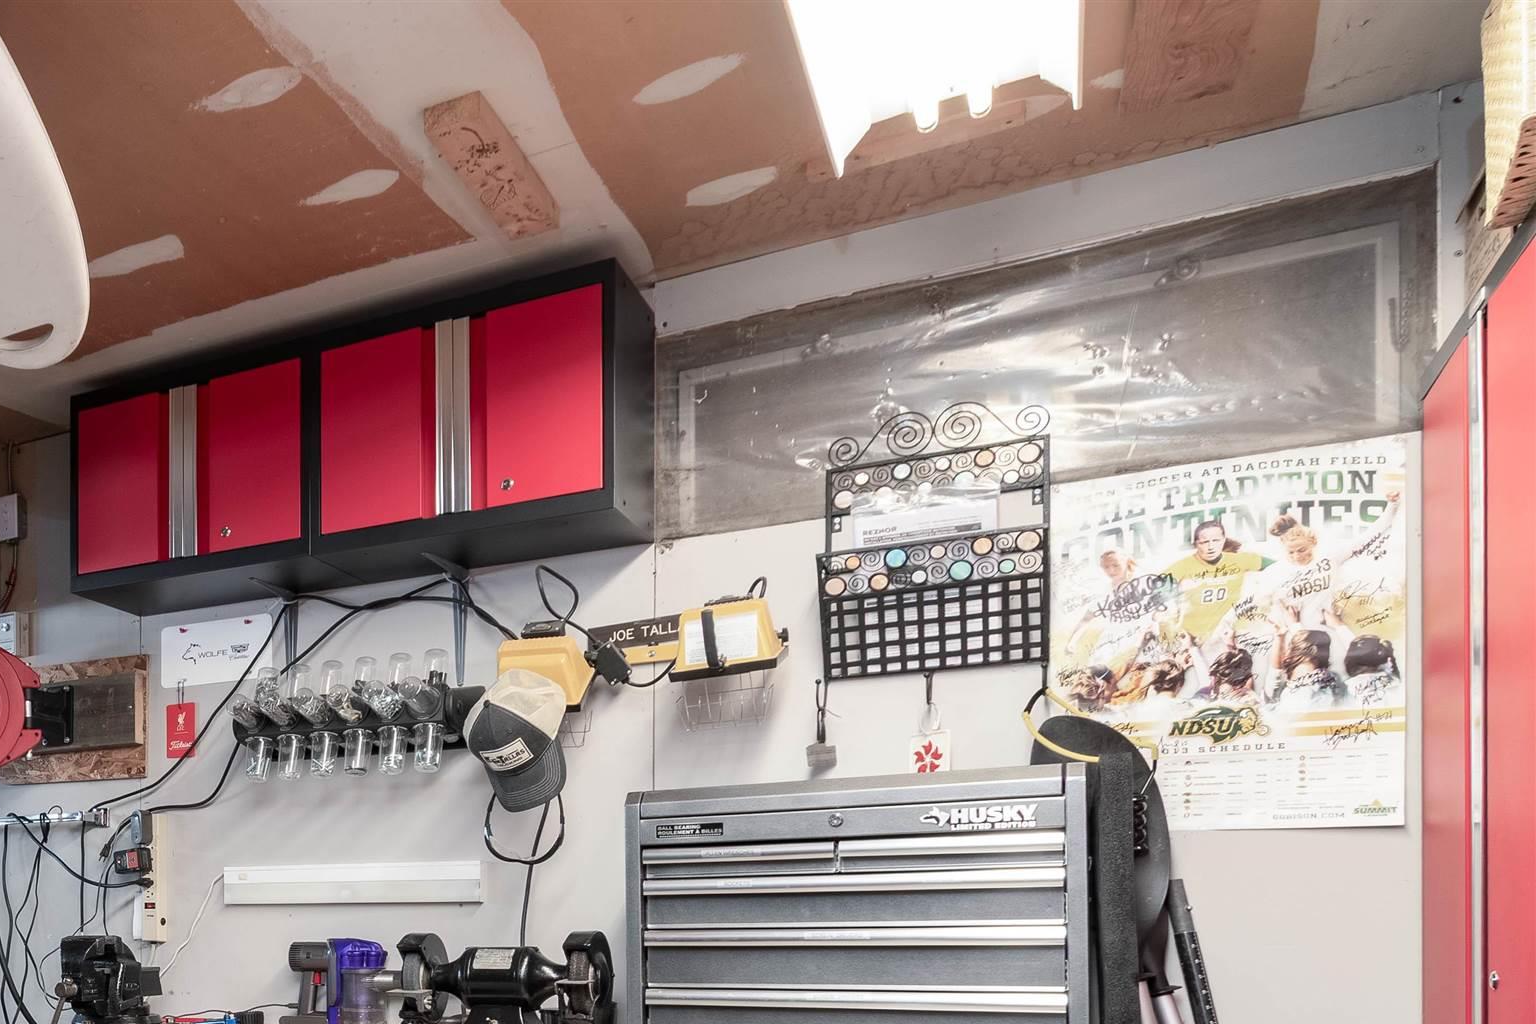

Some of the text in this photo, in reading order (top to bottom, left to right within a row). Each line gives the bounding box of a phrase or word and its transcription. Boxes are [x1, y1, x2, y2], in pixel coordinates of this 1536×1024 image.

[1202, 466, 1223, 477] AT
[1233, 457, 1321, 473] DACOTAH
[1330, 455, 1388, 466] FIELD
[1158, 469, 1377, 512] TRADITION
[1203, 588, 1226, 603] 20
[609, 622, 680, 642] JOE TALL
[198, 649, 229, 659] WOLFE
[1168, 717, 1237, 737] NDSU
[1198, 742, 1286, 753] SCHEDULE
[950, 802, 1039, 824] HUSKY
[1352, 806, 1398, 815] SUMMIT
[950, 820, 1037, 831] LIMITED EDITION
